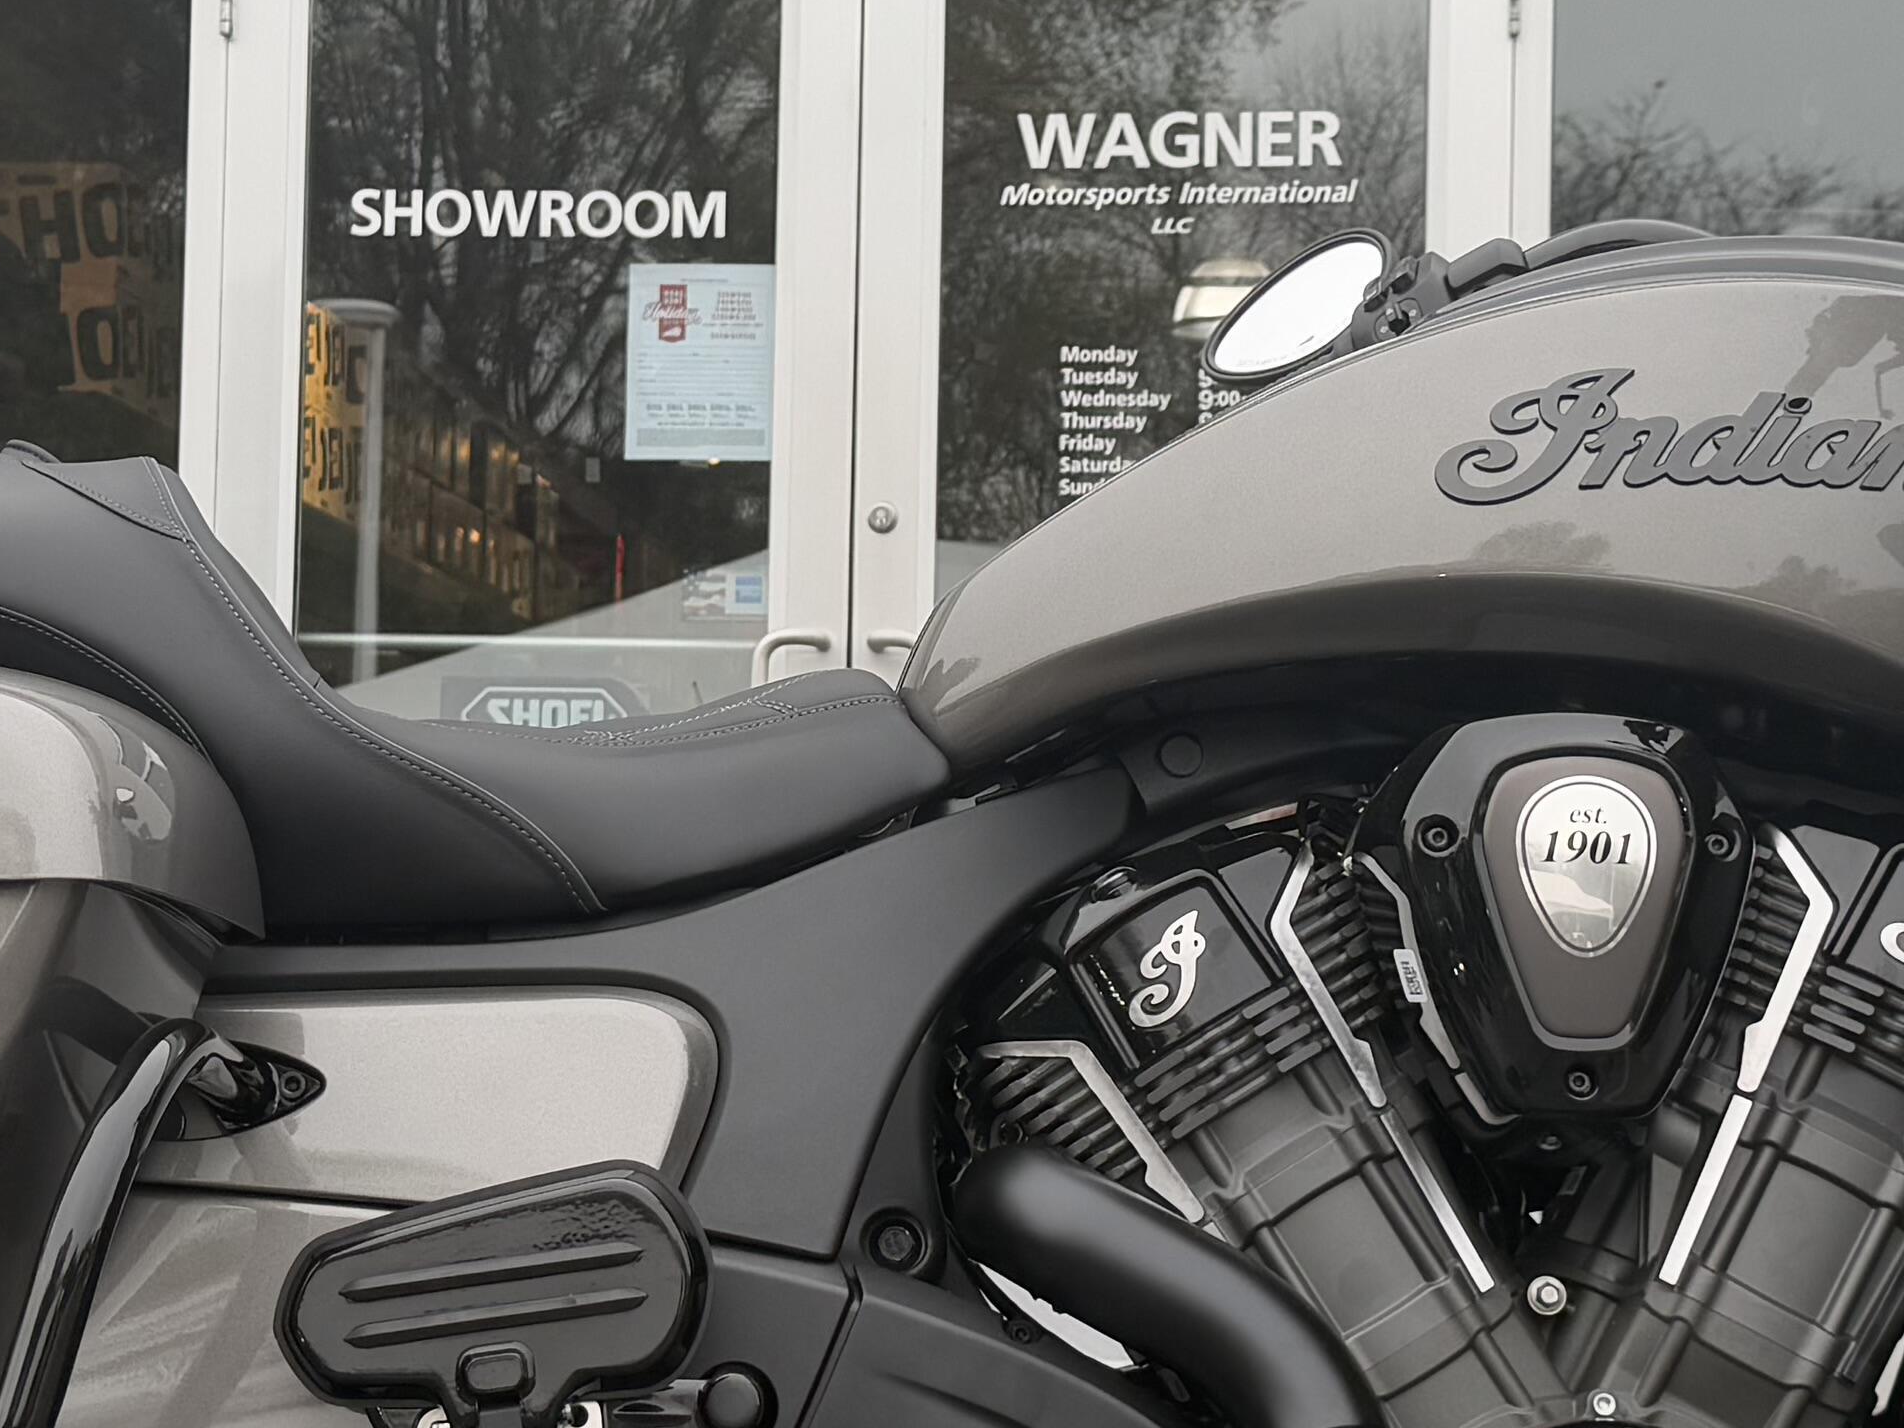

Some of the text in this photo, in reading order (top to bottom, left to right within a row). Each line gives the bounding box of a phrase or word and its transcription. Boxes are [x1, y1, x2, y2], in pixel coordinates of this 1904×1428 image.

[1017, 110, 1343, 169] WAGNER
[1000, 179, 1359, 211] Motorsports International
[349, 187, 728, 239] SHOWROOM
[1150, 217, 1195, 235] LLC
[1059, 345, 1138, 367] Monday
[1059, 368, 1138, 389] Tuesday
[1059, 389, 1171, 411] Wednesday
[1059, 412, 1147, 433] Thursday
[1058, 434, 1116, 455] Friday
[1569, 807, 1608, 824] est.
[1539, 830, 1632, 865] 1901
